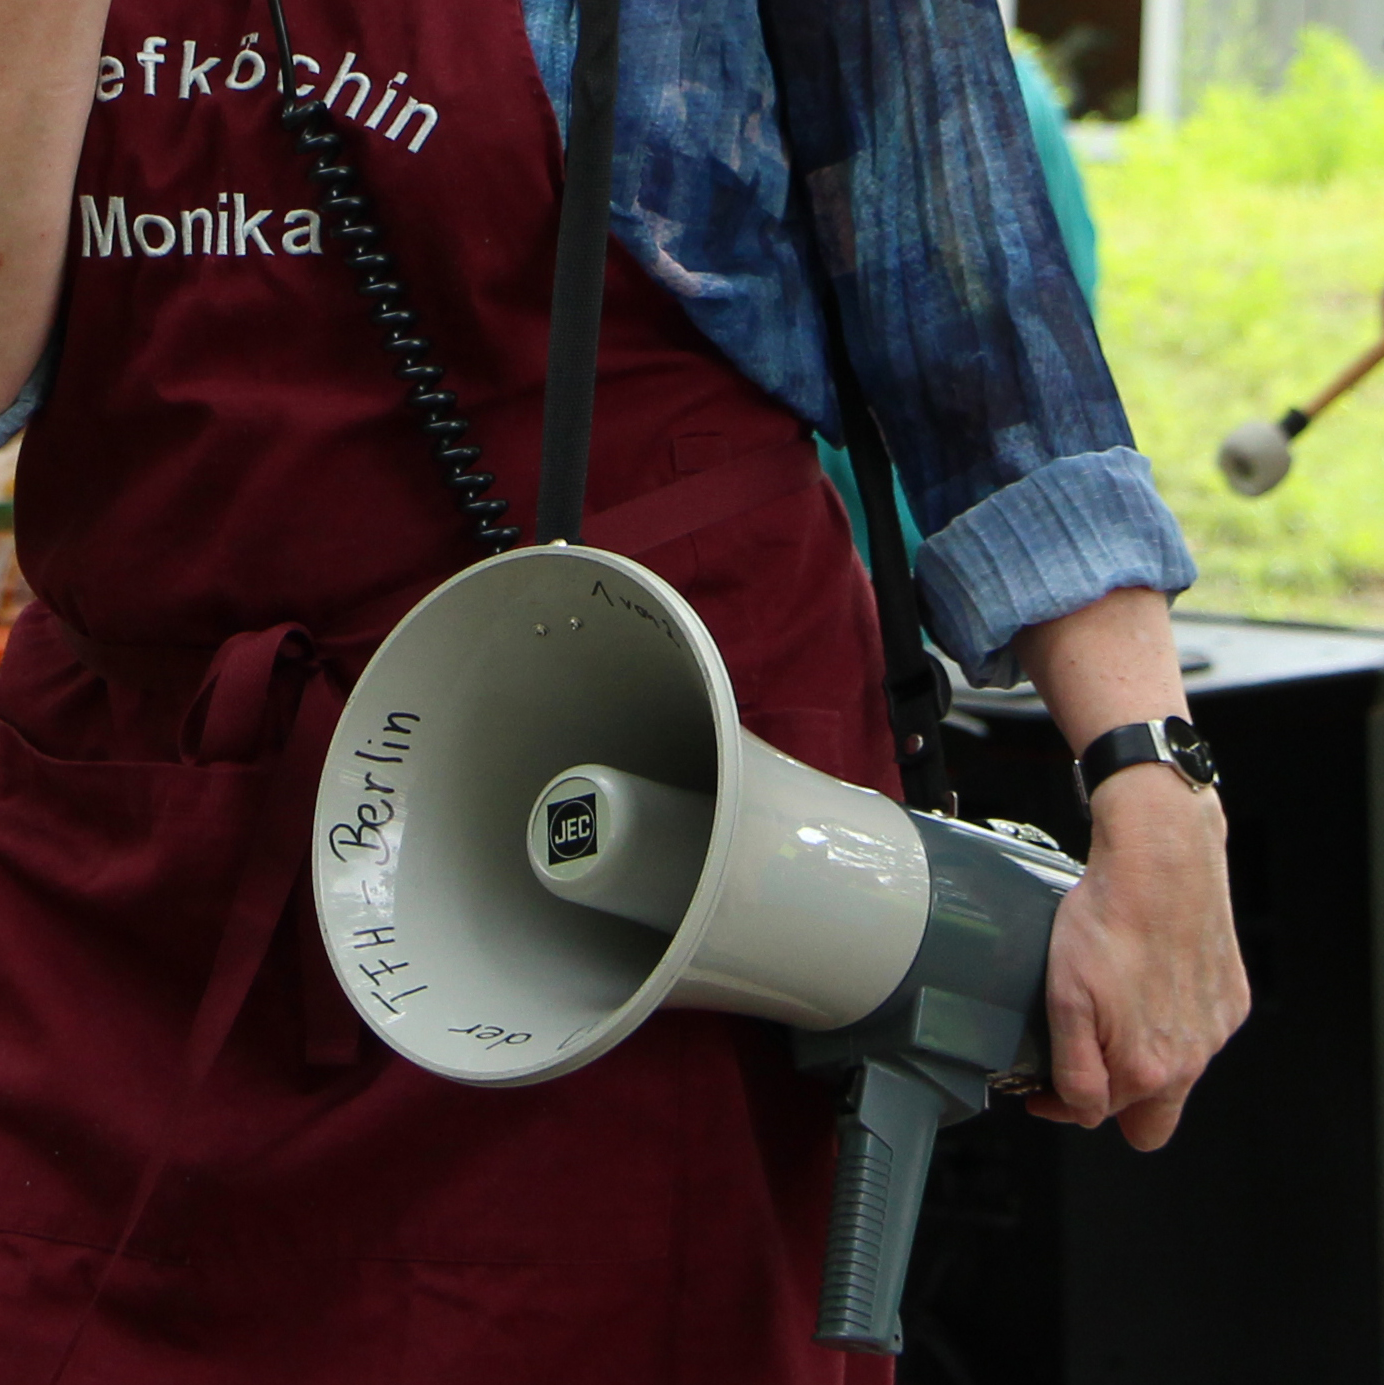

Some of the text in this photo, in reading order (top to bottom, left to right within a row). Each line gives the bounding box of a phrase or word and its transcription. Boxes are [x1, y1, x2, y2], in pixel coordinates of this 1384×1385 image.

[95, 32, 439, 154] efköchin
[79, 192, 324, 258] Monika
[554, 813, 591, 845] JEC
[447, 1023, 533, 1051] der
